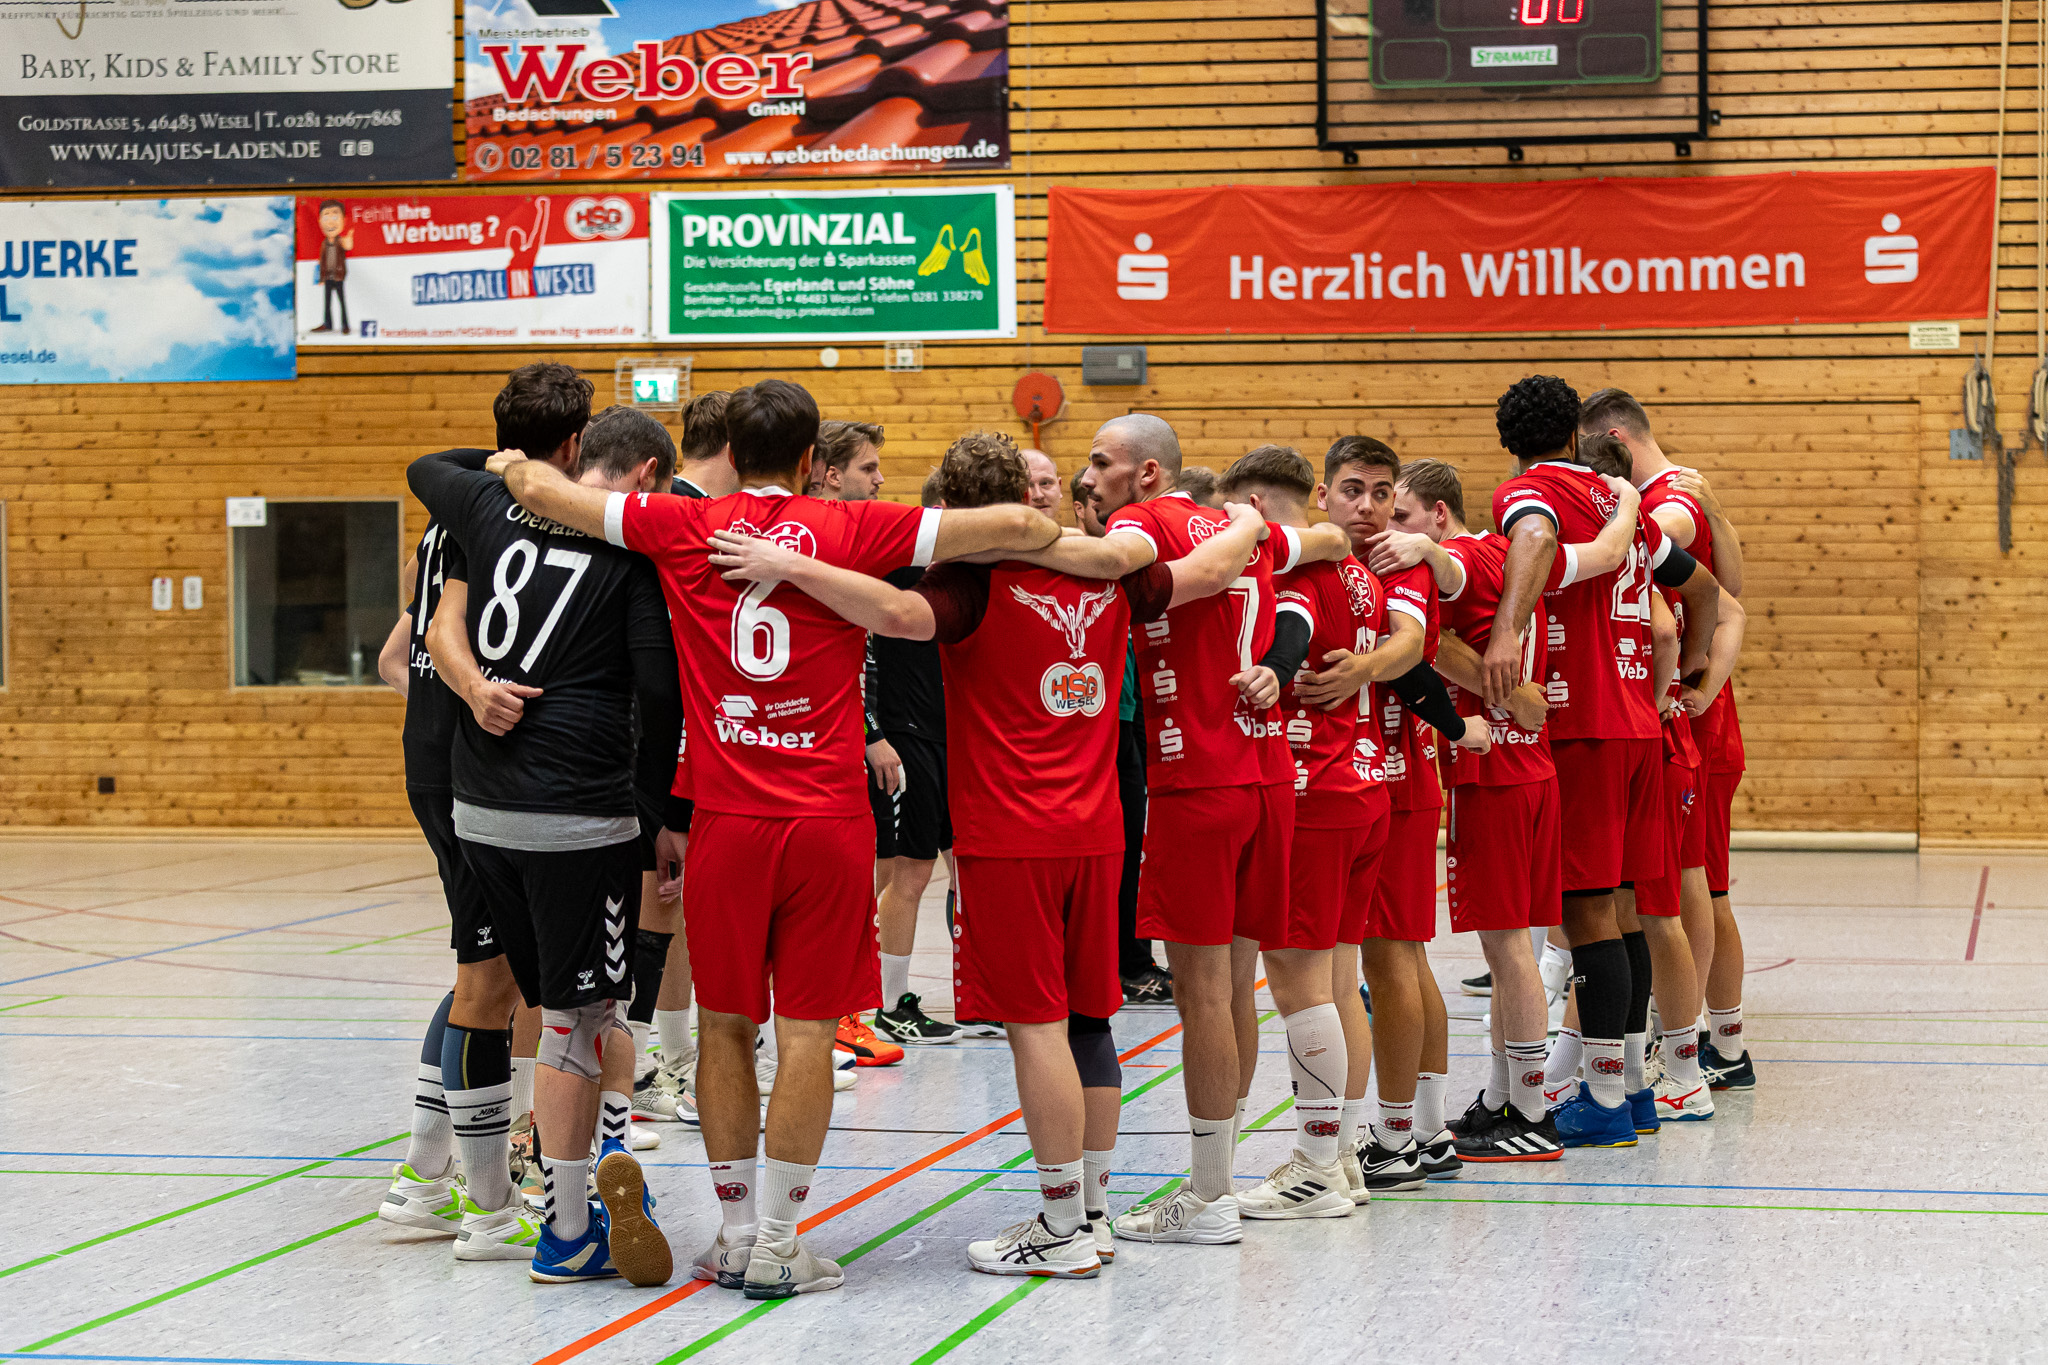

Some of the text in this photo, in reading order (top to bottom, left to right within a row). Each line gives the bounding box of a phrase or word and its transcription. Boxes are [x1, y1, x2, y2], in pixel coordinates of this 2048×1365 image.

[478, 27, 589, 39] Meisterbetrieb
[175, 57, 195, 78] &
[1476, 48, 1553, 63] STRAMATEL
[480, 41, 813, 102] Weber
[147, 113, 197, 133] 46483
[283, 109, 321, 129] 0281
[323, 108, 402, 130] 20677868
[493, 101, 806, 123] Bedachungen GmbH
[510, 145, 541, 169] 02
[549, 145, 578, 168] 81
[605, 144, 623, 168] 5
[632, 143, 663, 168] 23
[672, 142, 705, 166] 94
[724, 138, 999, 166] www.weberbedachungen.de
[352, 203, 431, 223] Fehlt Ihre
[683, 212, 916, 247] PROVINZIAL
[683, 252, 917, 271] Die Versicherung der Sparkassen
[1230, 247, 1806, 300] Herzlich Willkommen
[413, 264, 594, 303] HANDBALL IN WESEL
[764, 277, 835, 295] Egerlandt
[837, 276, 866, 291] und
[868, 275, 916, 291] Söhne
[478, 539, 592, 673] 87
[731, 580, 790, 682] 6
[1052, 672, 1098, 701] HSG
[764, 697, 810, 712] Ihr Dachdecker
[1056, 696, 1094, 709] WESEL
[714, 719, 816, 749] Weber
[478, 1106, 503, 1117] NIKE
